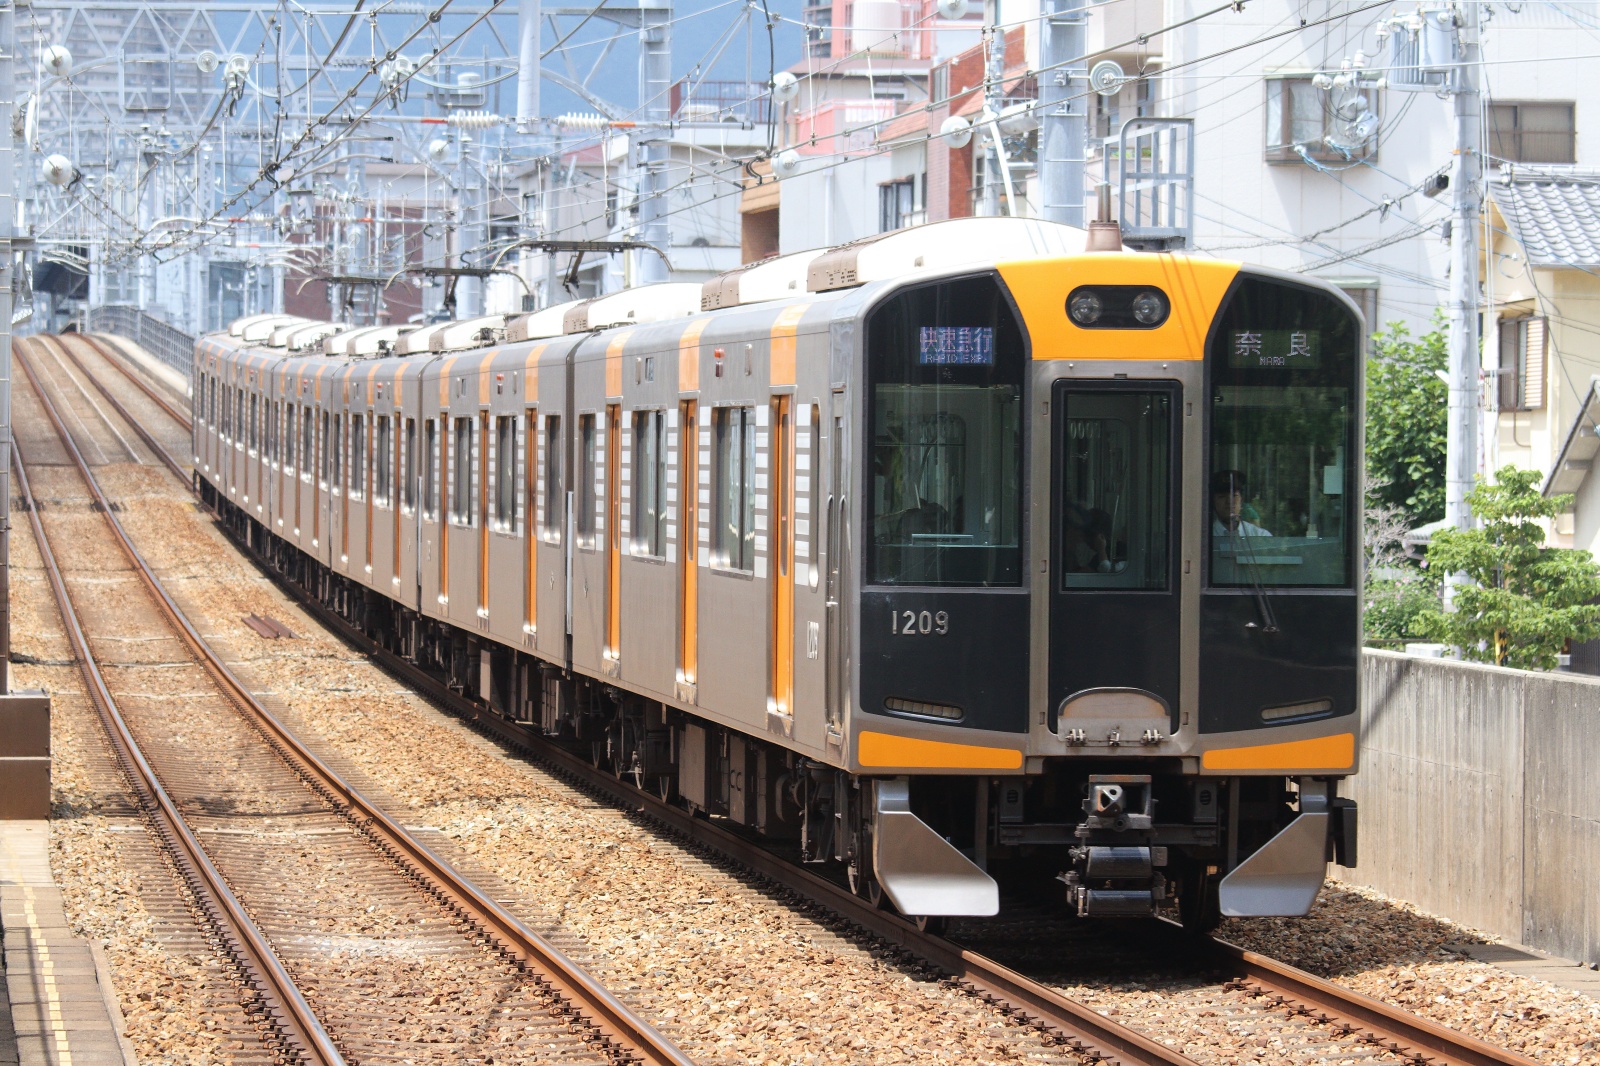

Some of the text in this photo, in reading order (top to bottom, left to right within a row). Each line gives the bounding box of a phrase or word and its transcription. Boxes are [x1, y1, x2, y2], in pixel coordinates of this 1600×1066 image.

[920, 327, 992, 353] 快速急行
[1235, 331, 1310, 356] 奈良
[1259, 357, 1285, 365] NARA
[892, 611, 949, 635] 1209
